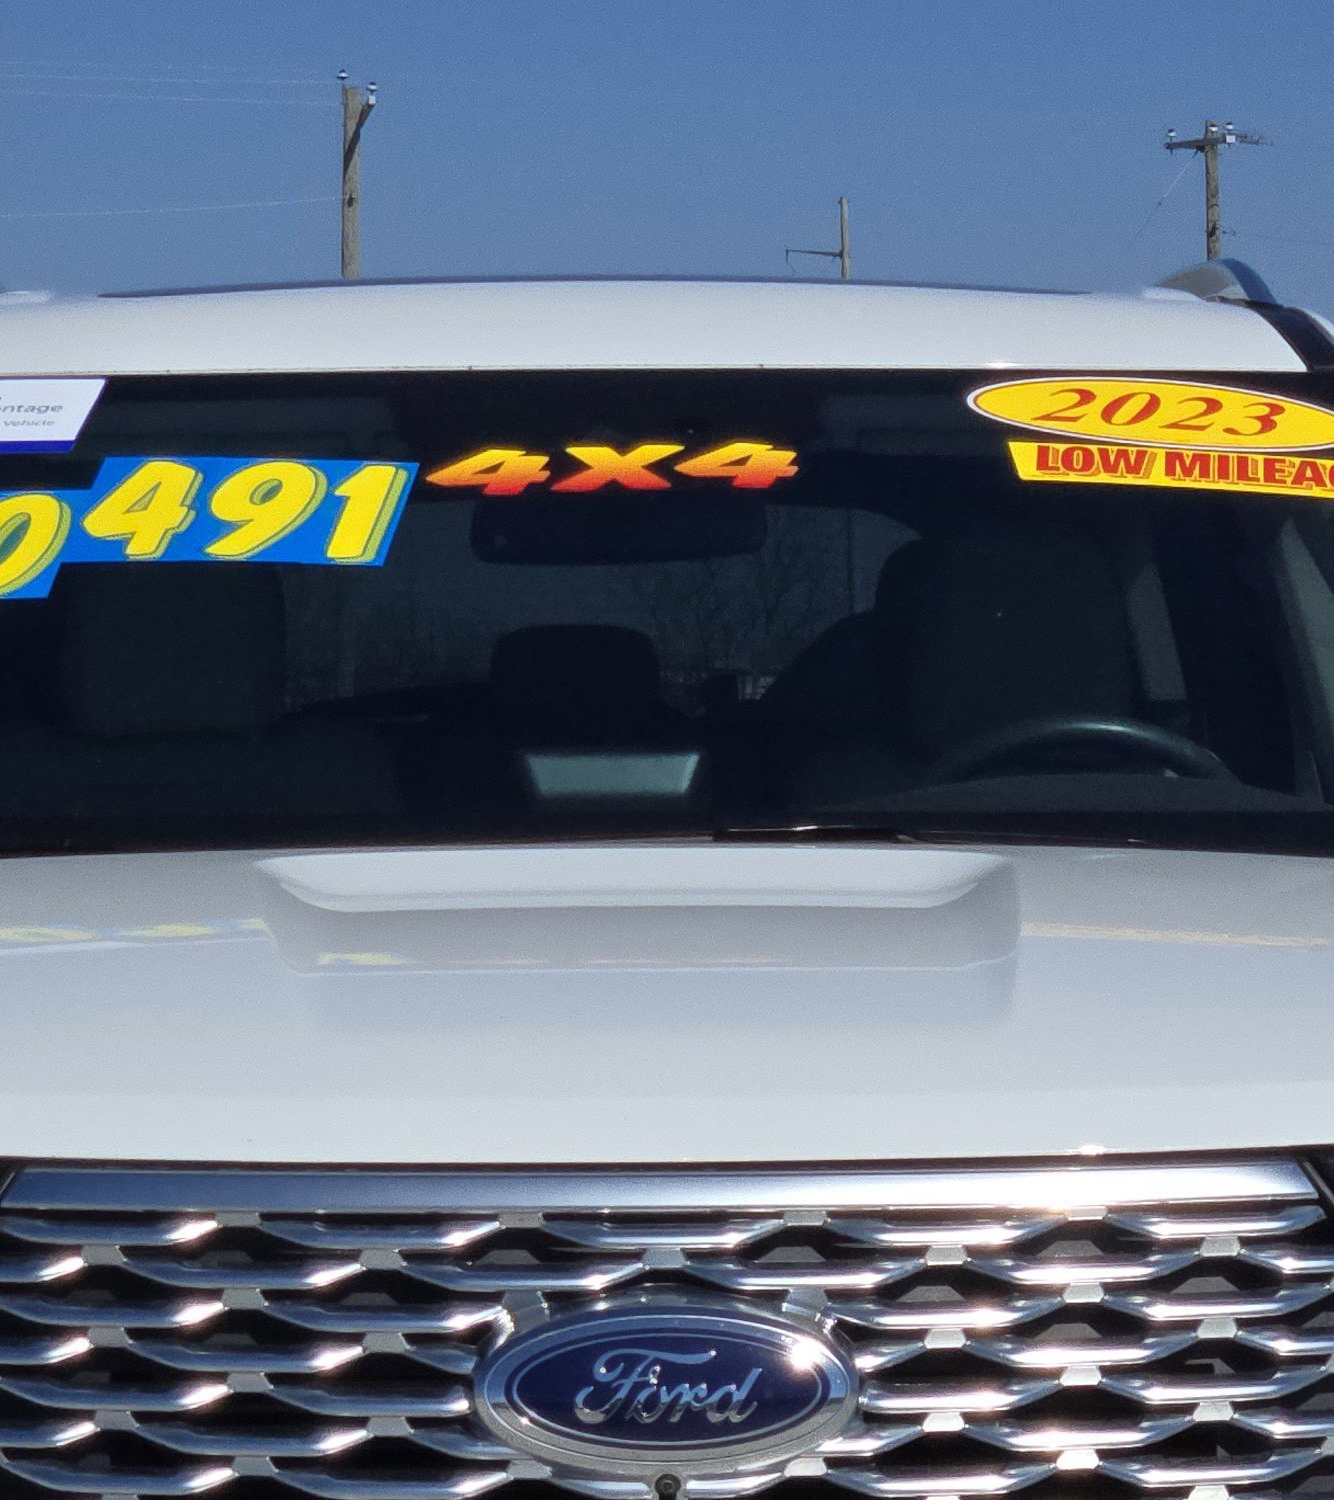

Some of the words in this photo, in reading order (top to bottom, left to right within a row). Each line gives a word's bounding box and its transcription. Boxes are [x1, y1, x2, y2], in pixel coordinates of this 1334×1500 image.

[3, 418, 56, 428] Vehicle
[1030, 387, 1287, 437] 2023
[425, 442, 799, 496] 4X4
[1035, 444, 1153, 476] LOW
[573, 1347, 763, 1424] Ford
